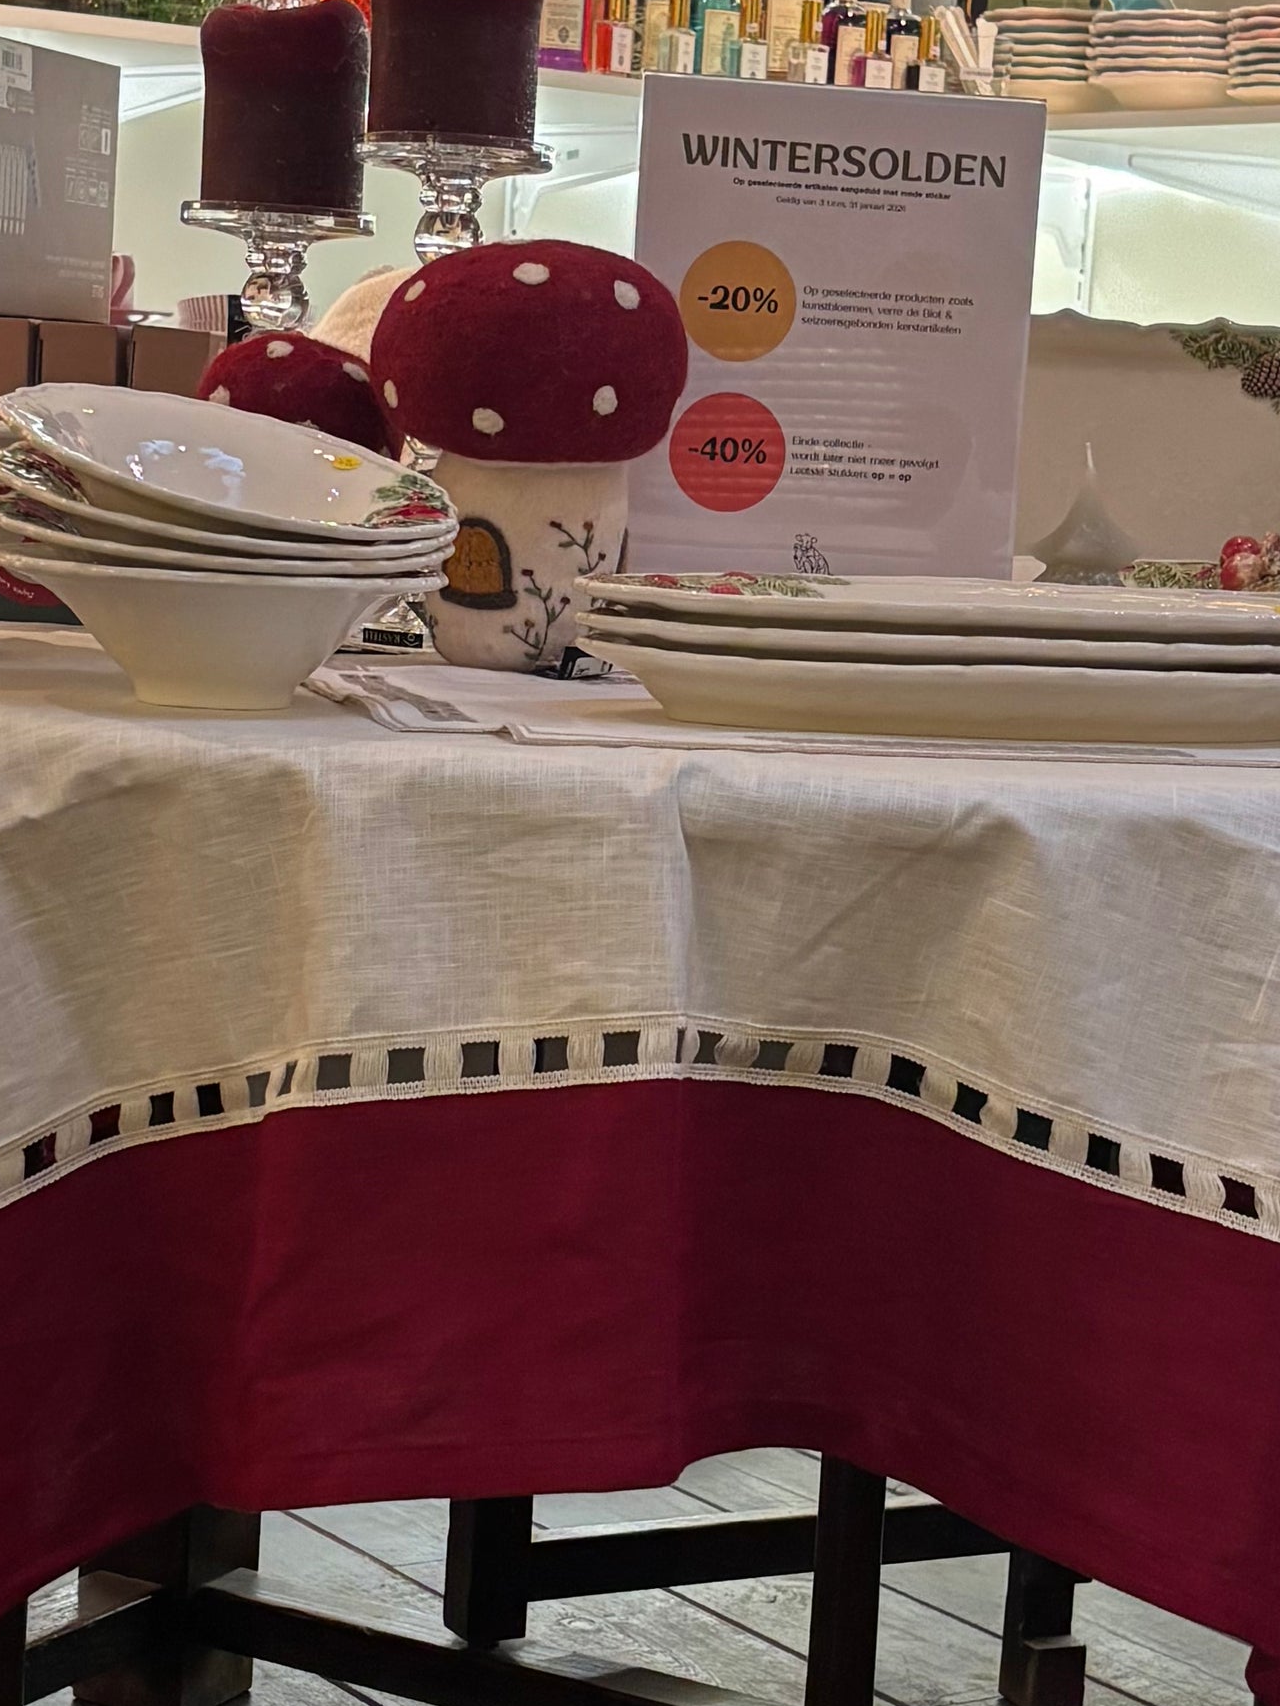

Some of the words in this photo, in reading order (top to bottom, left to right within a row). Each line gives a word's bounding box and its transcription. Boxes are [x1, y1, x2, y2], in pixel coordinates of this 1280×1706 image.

[681, 132, 1007, 188] WINTERSOLDEN
[733, 177, 746, 187] Op
[696, 284, 780, 316] -20%
[803, 285, 819, 297] Op
[821, 289, 892, 301] geselecteerde
[894, 293, 945, 305] producten
[948, 296, 974, 306] zoals
[877, 307, 904, 316] verre
[944, 311, 953, 319] &
[801, 316, 894, 331] seizoensgebonden
[896, 322, 962, 335] kerstartikelen
[791, 435, 820, 446] Einde
[823, 438, 865, 449] collectie
[687, 435, 768, 466] -40%
[847, 454, 867, 464] niet
[870, 457, 896, 466] meer
[871, 472, 885, 481] op
[898, 473, 912, 482] op
